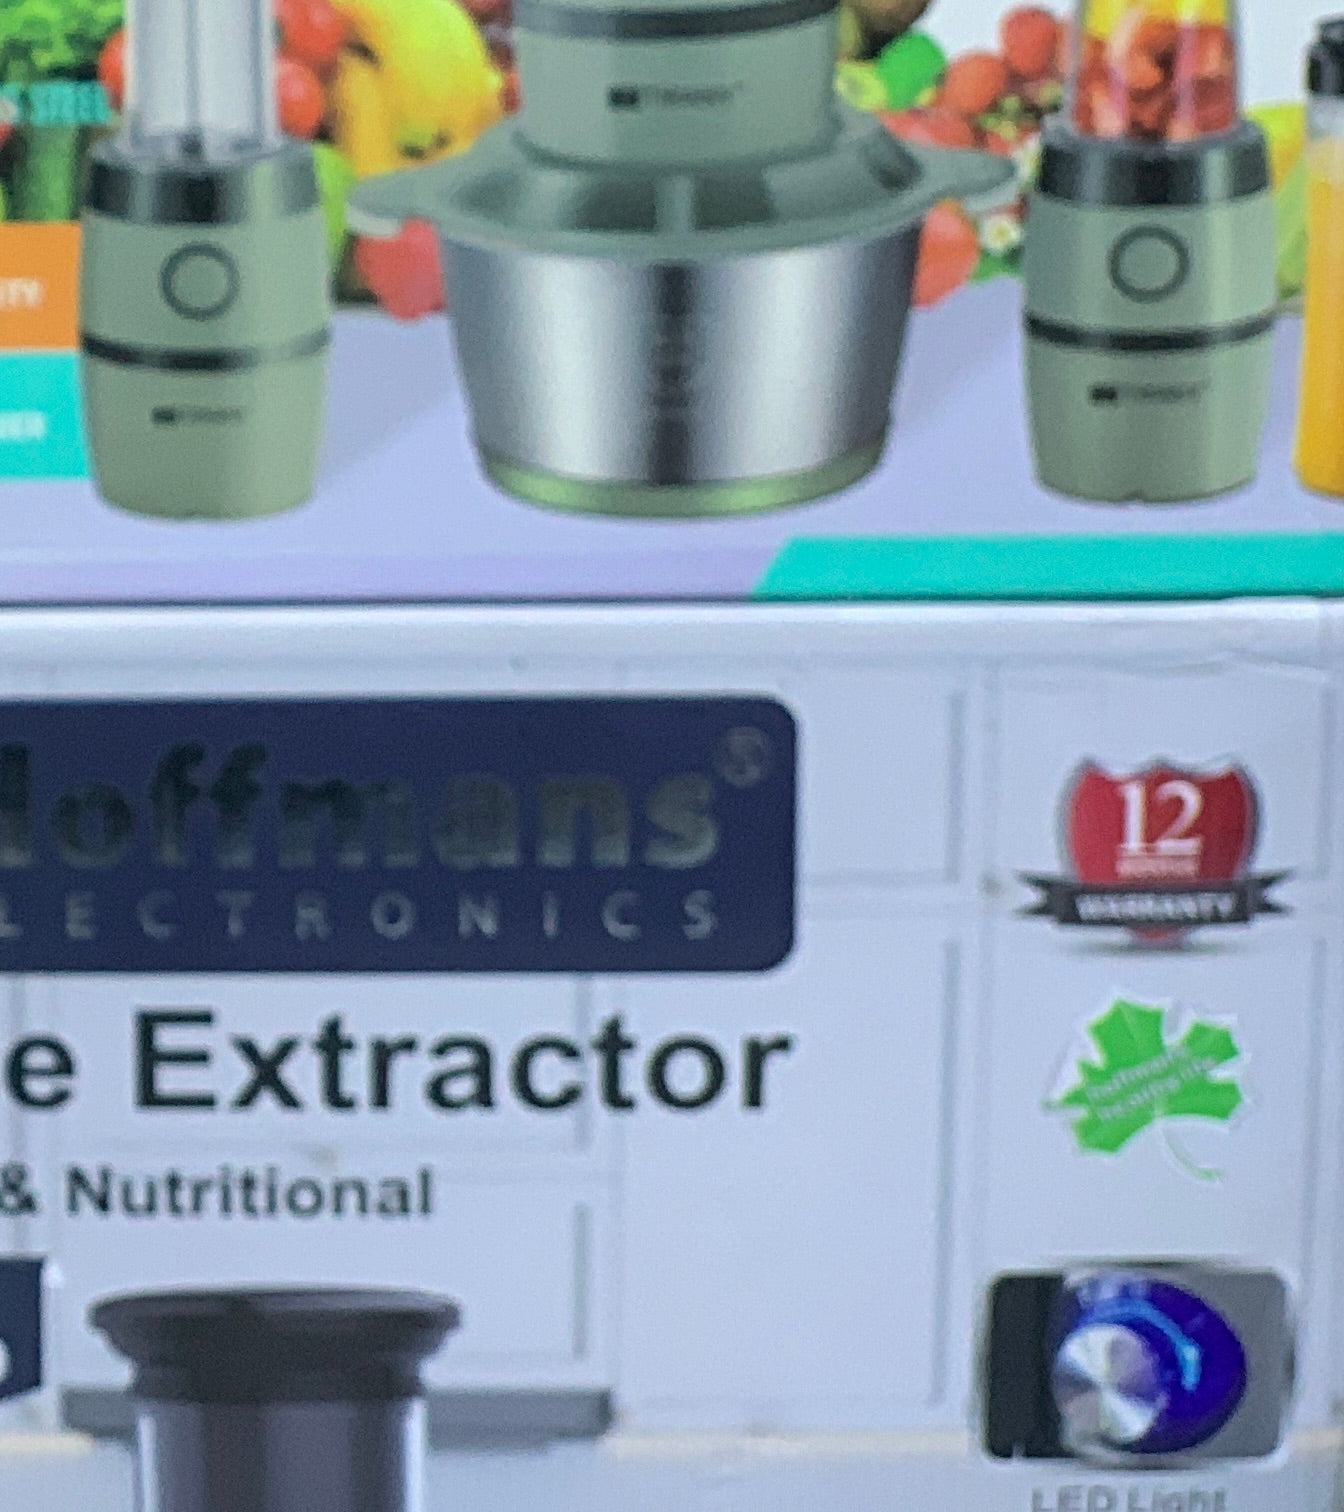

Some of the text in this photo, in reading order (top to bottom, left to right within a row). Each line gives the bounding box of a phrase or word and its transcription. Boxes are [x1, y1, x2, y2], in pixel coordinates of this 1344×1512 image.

[1116, 779, 1204, 856] 12
[133, 1005, 794, 1112] Extractor
[64, 1160, 433, 1219] Nutritional
